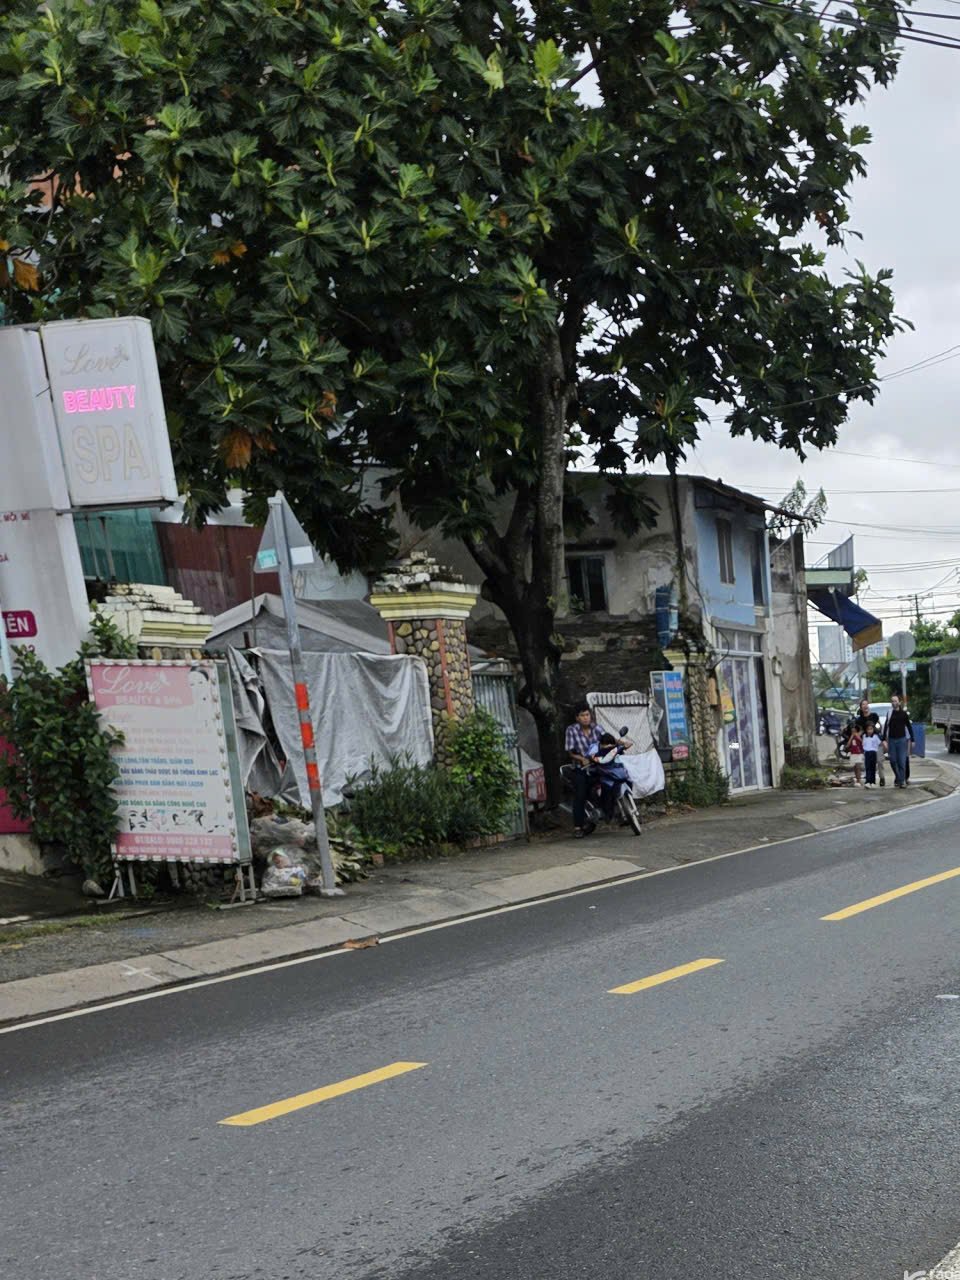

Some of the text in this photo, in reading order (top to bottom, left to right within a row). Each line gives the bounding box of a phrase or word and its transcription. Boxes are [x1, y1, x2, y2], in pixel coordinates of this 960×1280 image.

[63, 384, 136, 414] BEAUTY
[71, 423, 149, 484] SPA
[98, 666, 161, 694] Love
